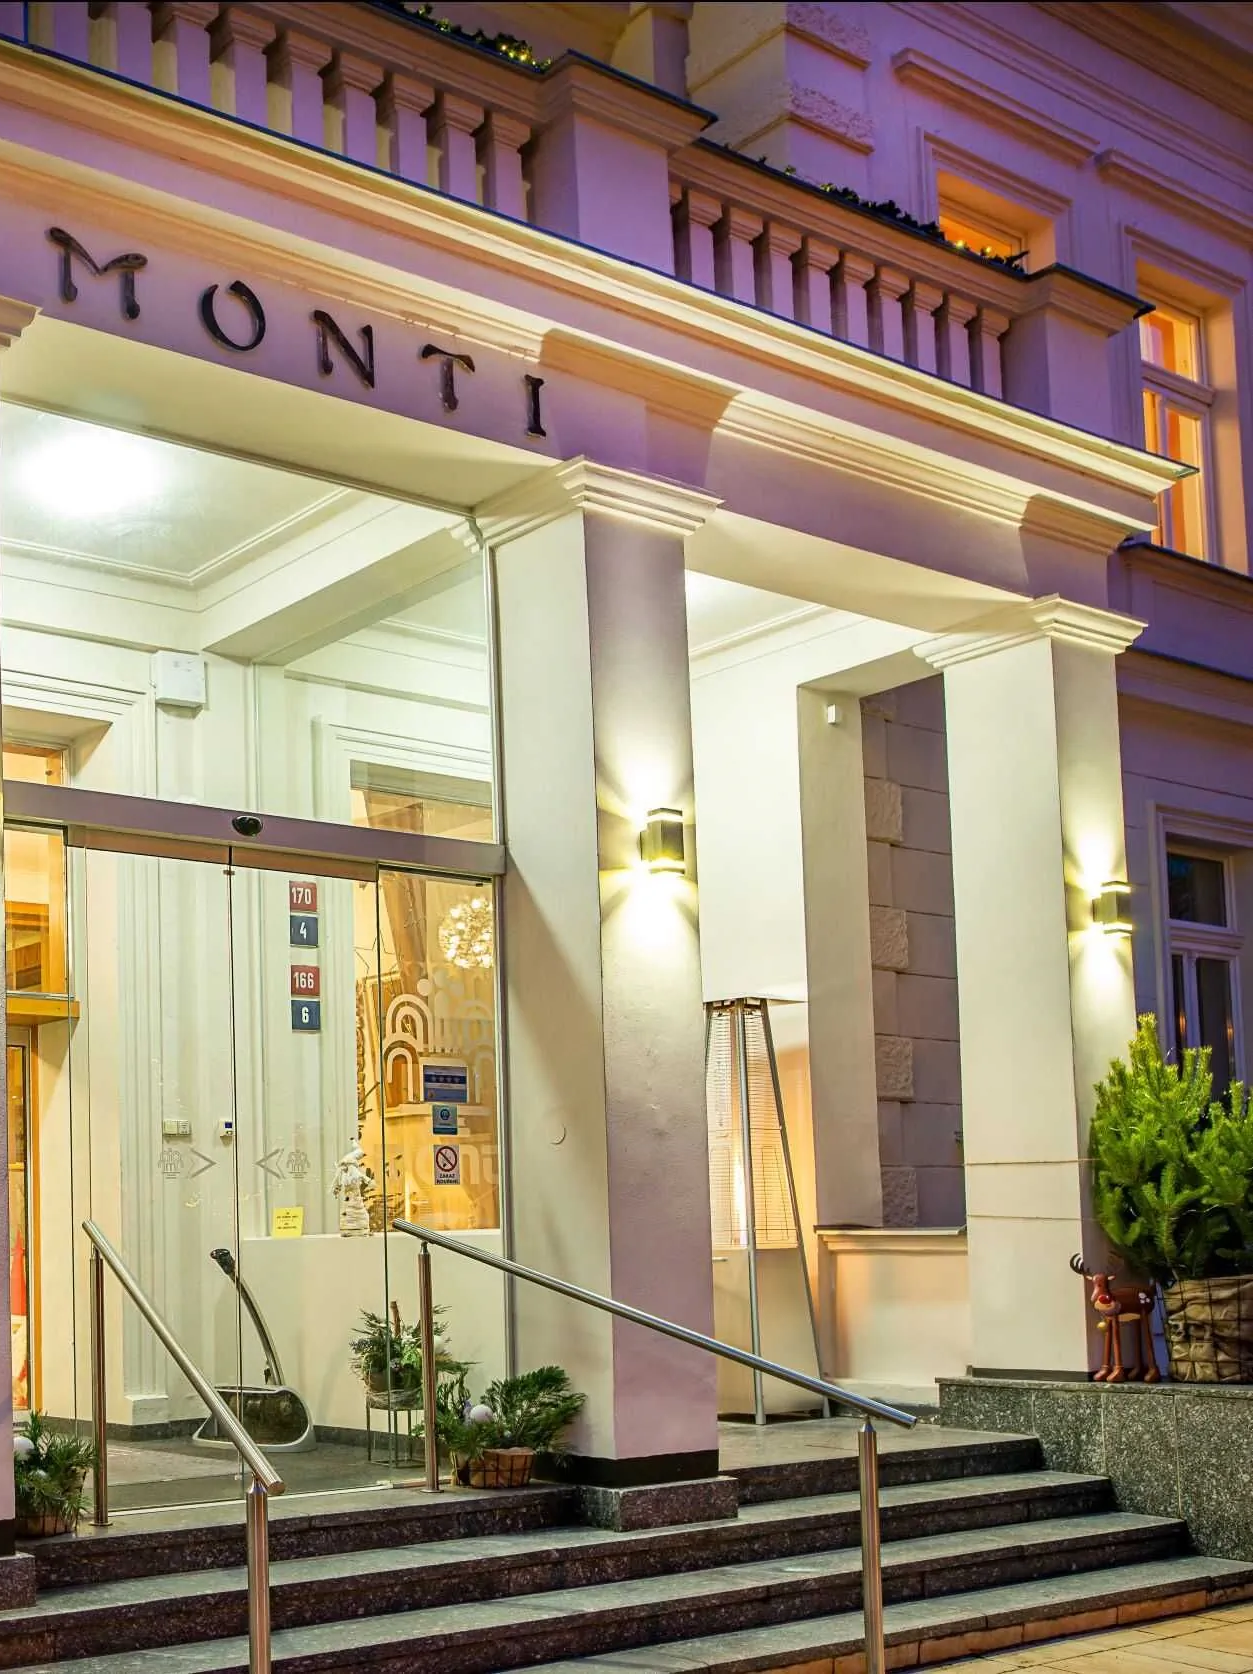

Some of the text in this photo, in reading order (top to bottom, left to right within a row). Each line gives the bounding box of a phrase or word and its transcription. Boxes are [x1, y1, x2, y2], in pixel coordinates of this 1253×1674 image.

[44, 225, 548, 438] MONTI
[291, 887, 312, 905] 170
[299, 921, 307, 940] 4
[293, 971, 315, 989] 166
[301, 1006, 309, 1024] 6
